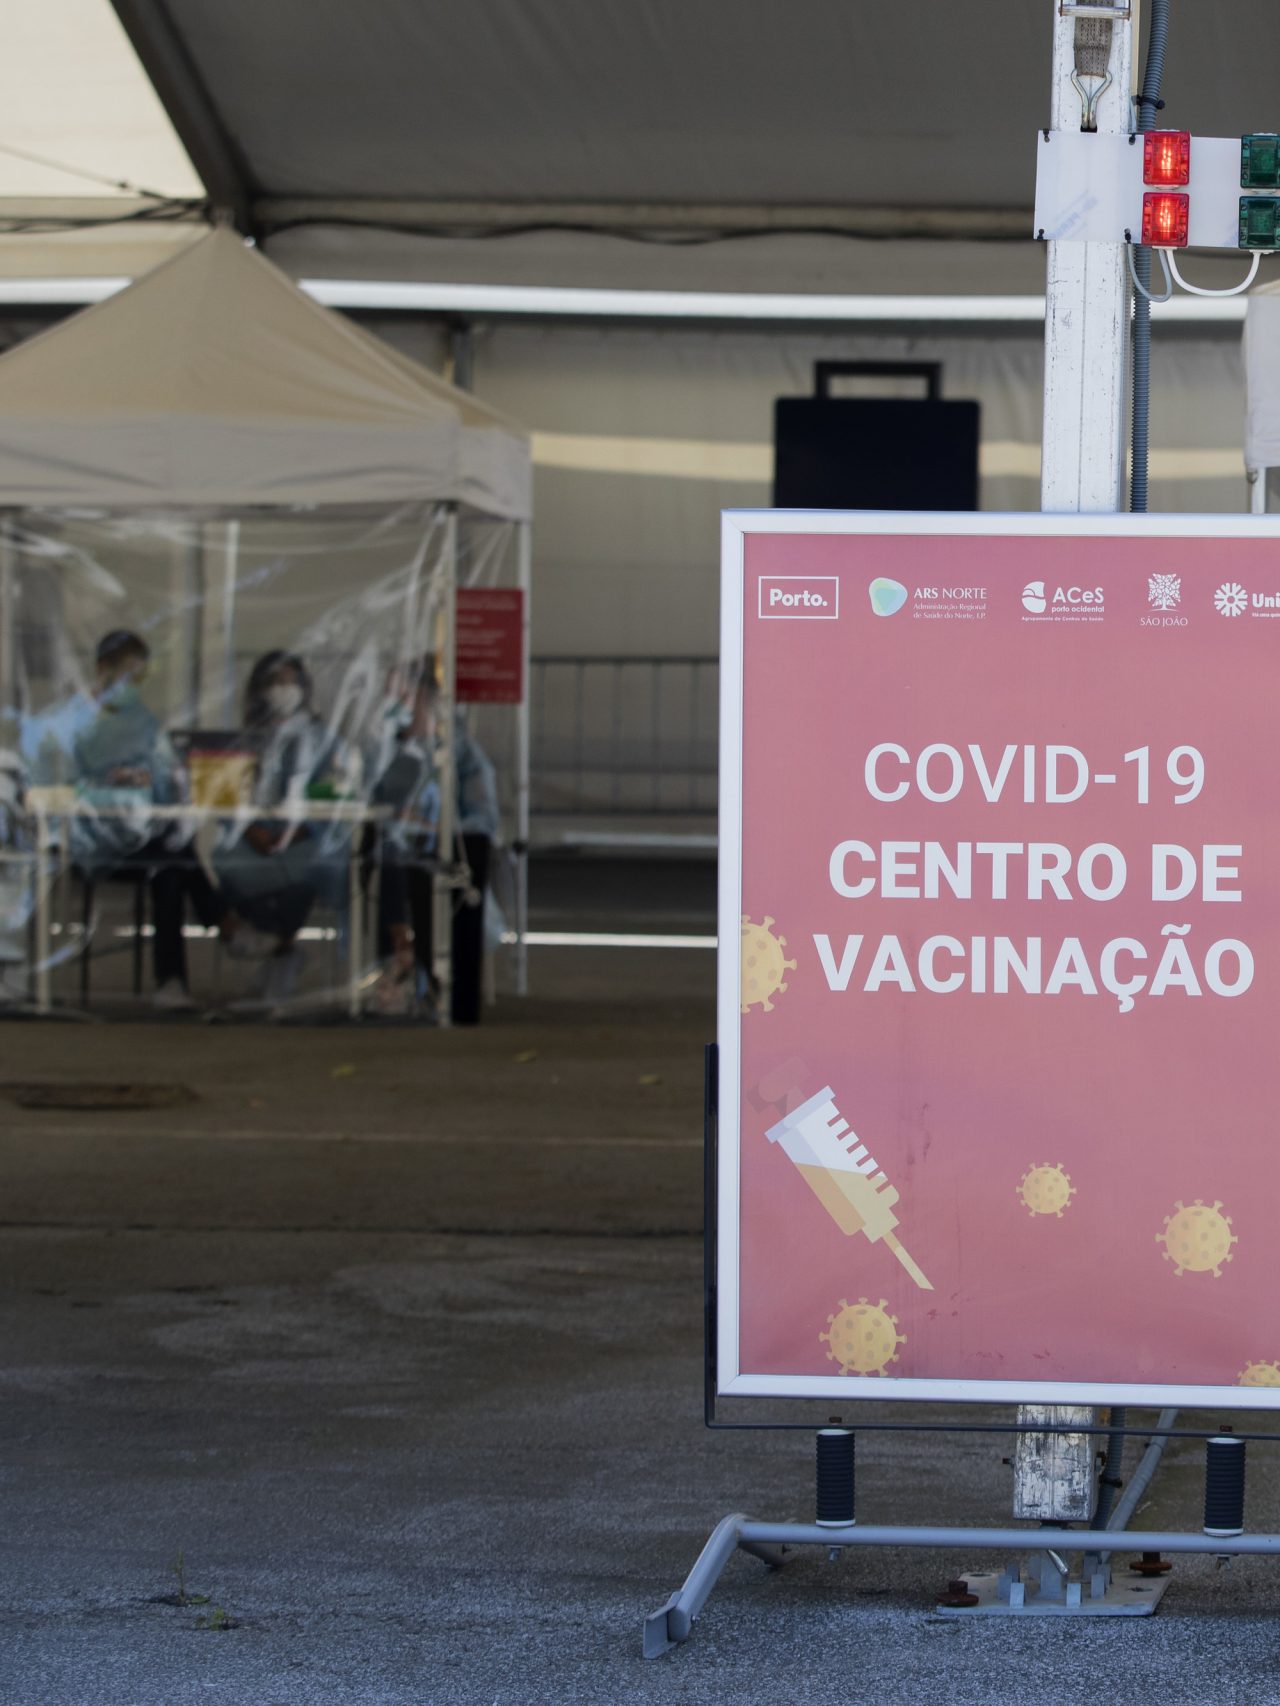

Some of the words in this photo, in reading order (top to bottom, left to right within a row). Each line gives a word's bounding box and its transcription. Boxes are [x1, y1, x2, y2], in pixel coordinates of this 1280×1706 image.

[770, 588, 828, 607] Porto.
[914, 587, 938, 600] ARS
[942, 587, 987, 600] NORTE
[1052, 587, 1104, 604] ACeS
[960, 603, 986, 612] Regional
[1052, 606, 1070, 614] porto
[1140, 616, 1160, 626] SÃO
[1162, 616, 1188, 627] JOÃO
[864, 742, 1205, 804] COVID-19
[828, 840, 1127, 901] CENTRO
[1152, 844, 1243, 902] DE
[812, 923, 1255, 1013] VACINAÇÃO
